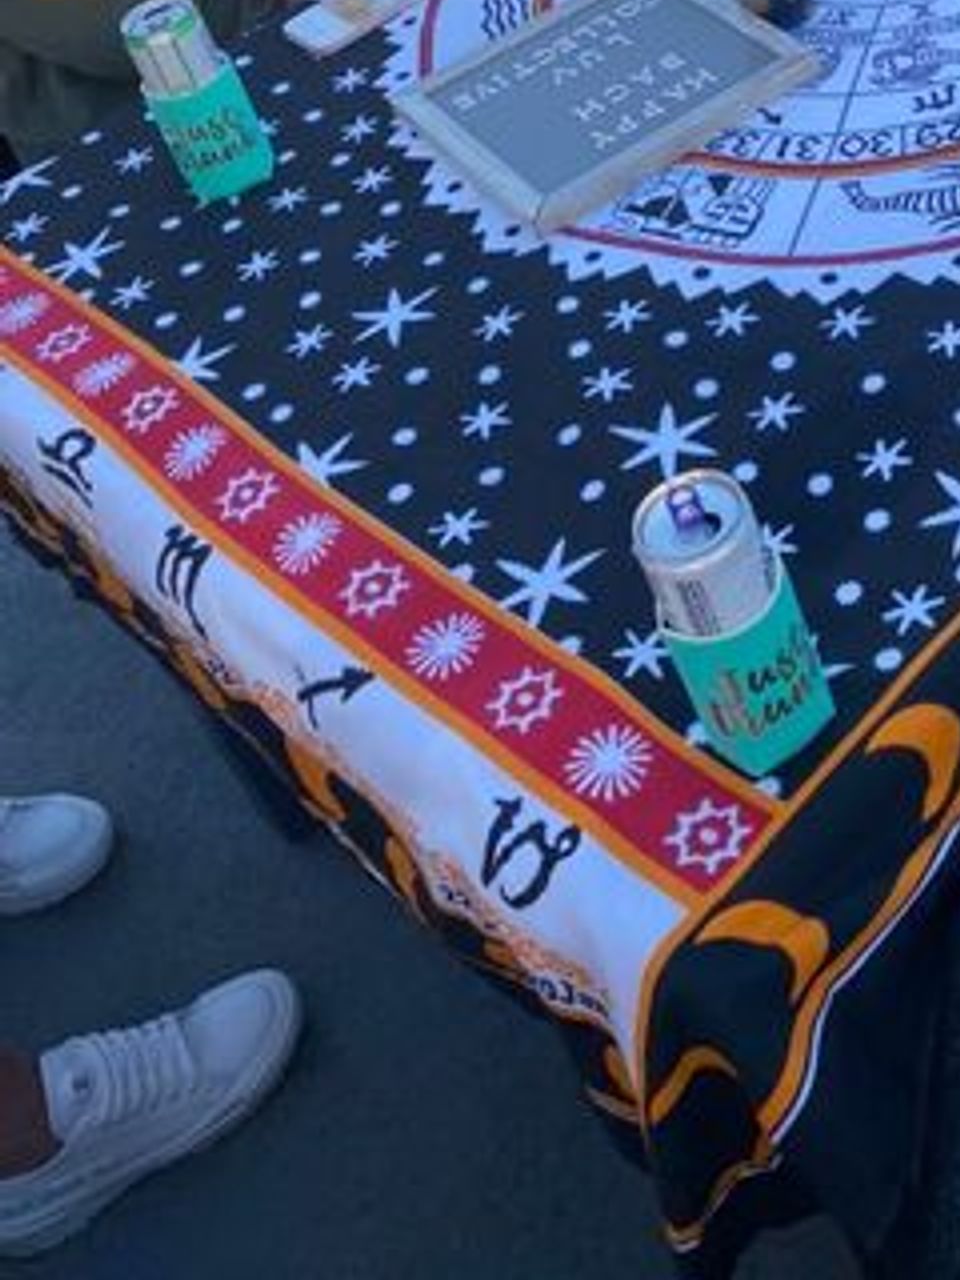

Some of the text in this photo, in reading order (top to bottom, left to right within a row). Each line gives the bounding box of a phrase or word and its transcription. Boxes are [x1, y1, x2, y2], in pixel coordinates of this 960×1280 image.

[552, 31, 634, 87] LUV
[573, 52, 686, 122] BACH
[591, 67, 719, 151] HAPPY
[774, 134, 823, 160] 31
[839, 129, 894, 157] 30
